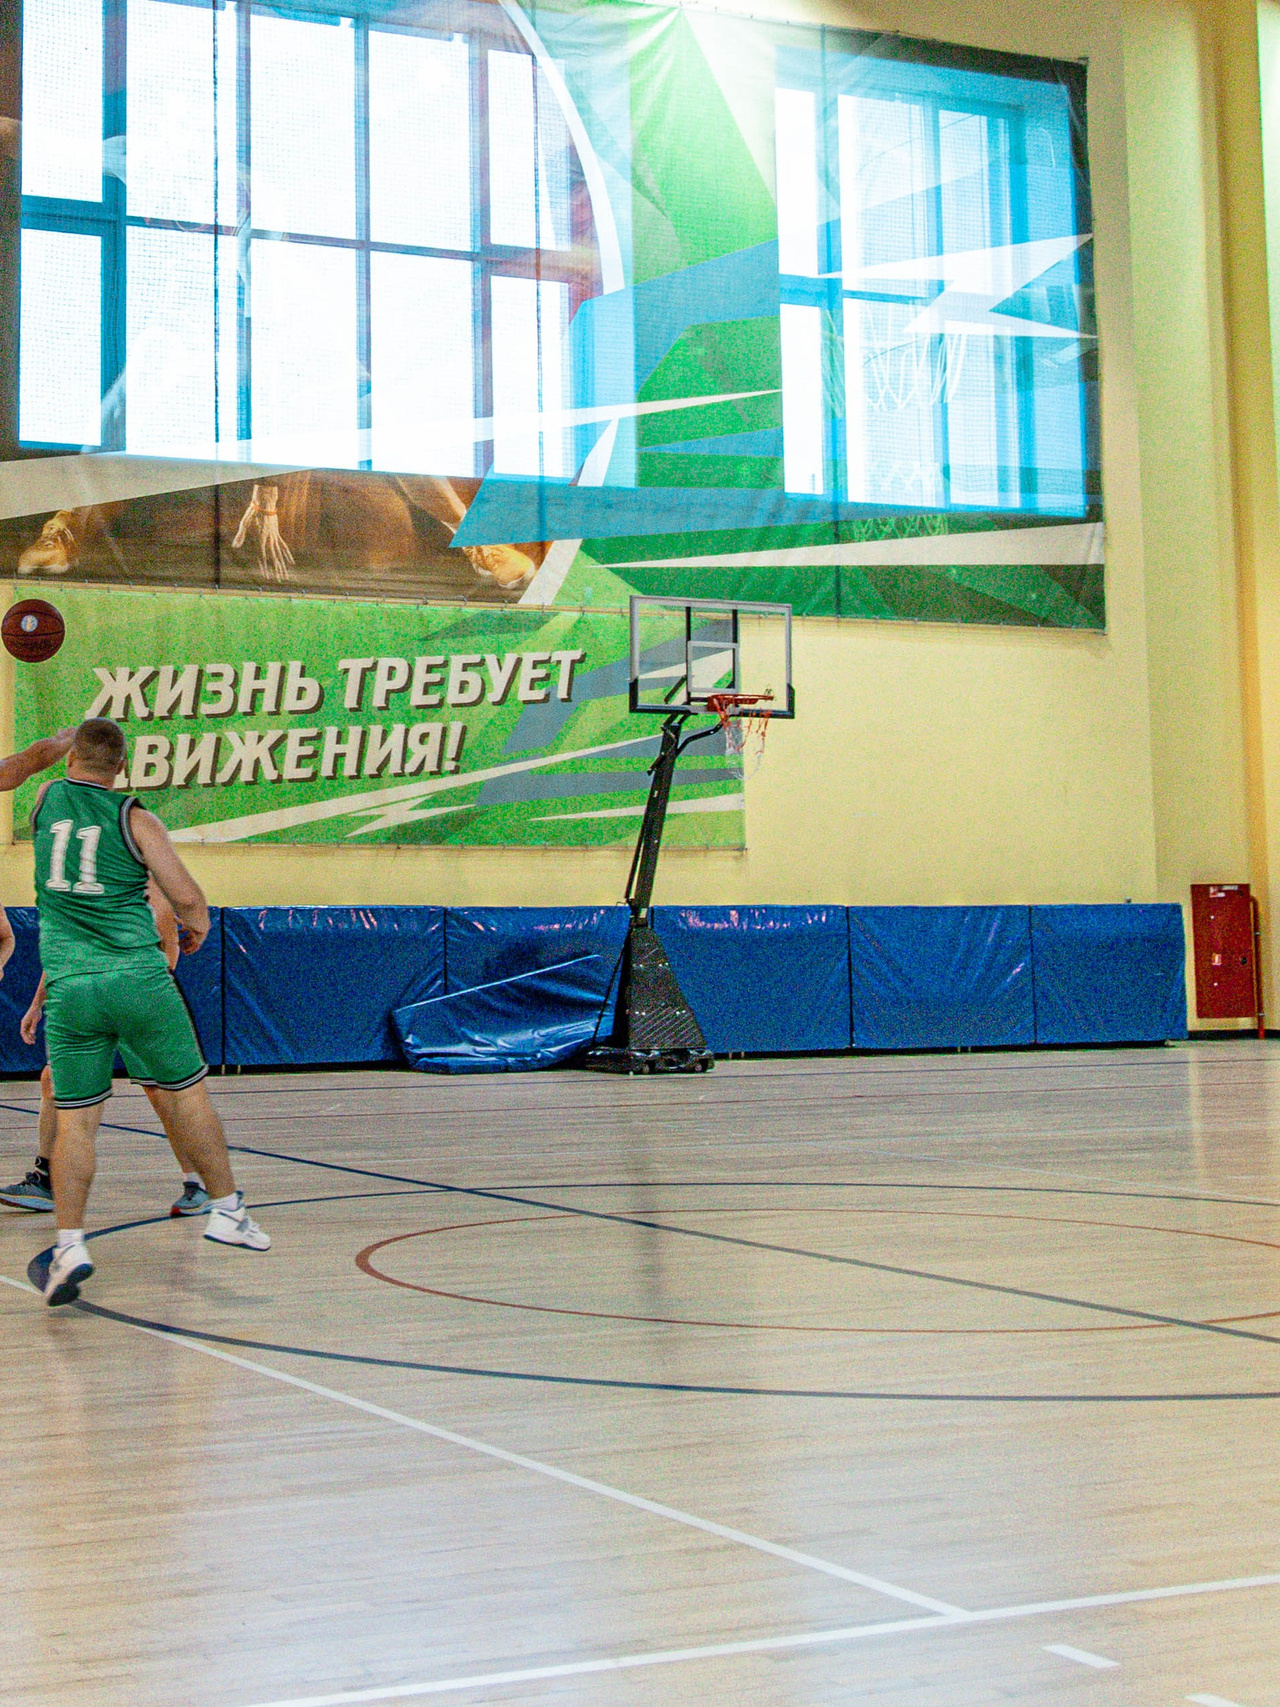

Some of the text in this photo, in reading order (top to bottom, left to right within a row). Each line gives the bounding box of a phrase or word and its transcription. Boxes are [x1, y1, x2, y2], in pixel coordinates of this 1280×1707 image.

[85, 648, 586, 721] ЖИЗНЬ ТРЕБУЕТ
[114, 721, 466, 790] ВИЖЕНИЯ!
[45, 819, 105, 894] 11
